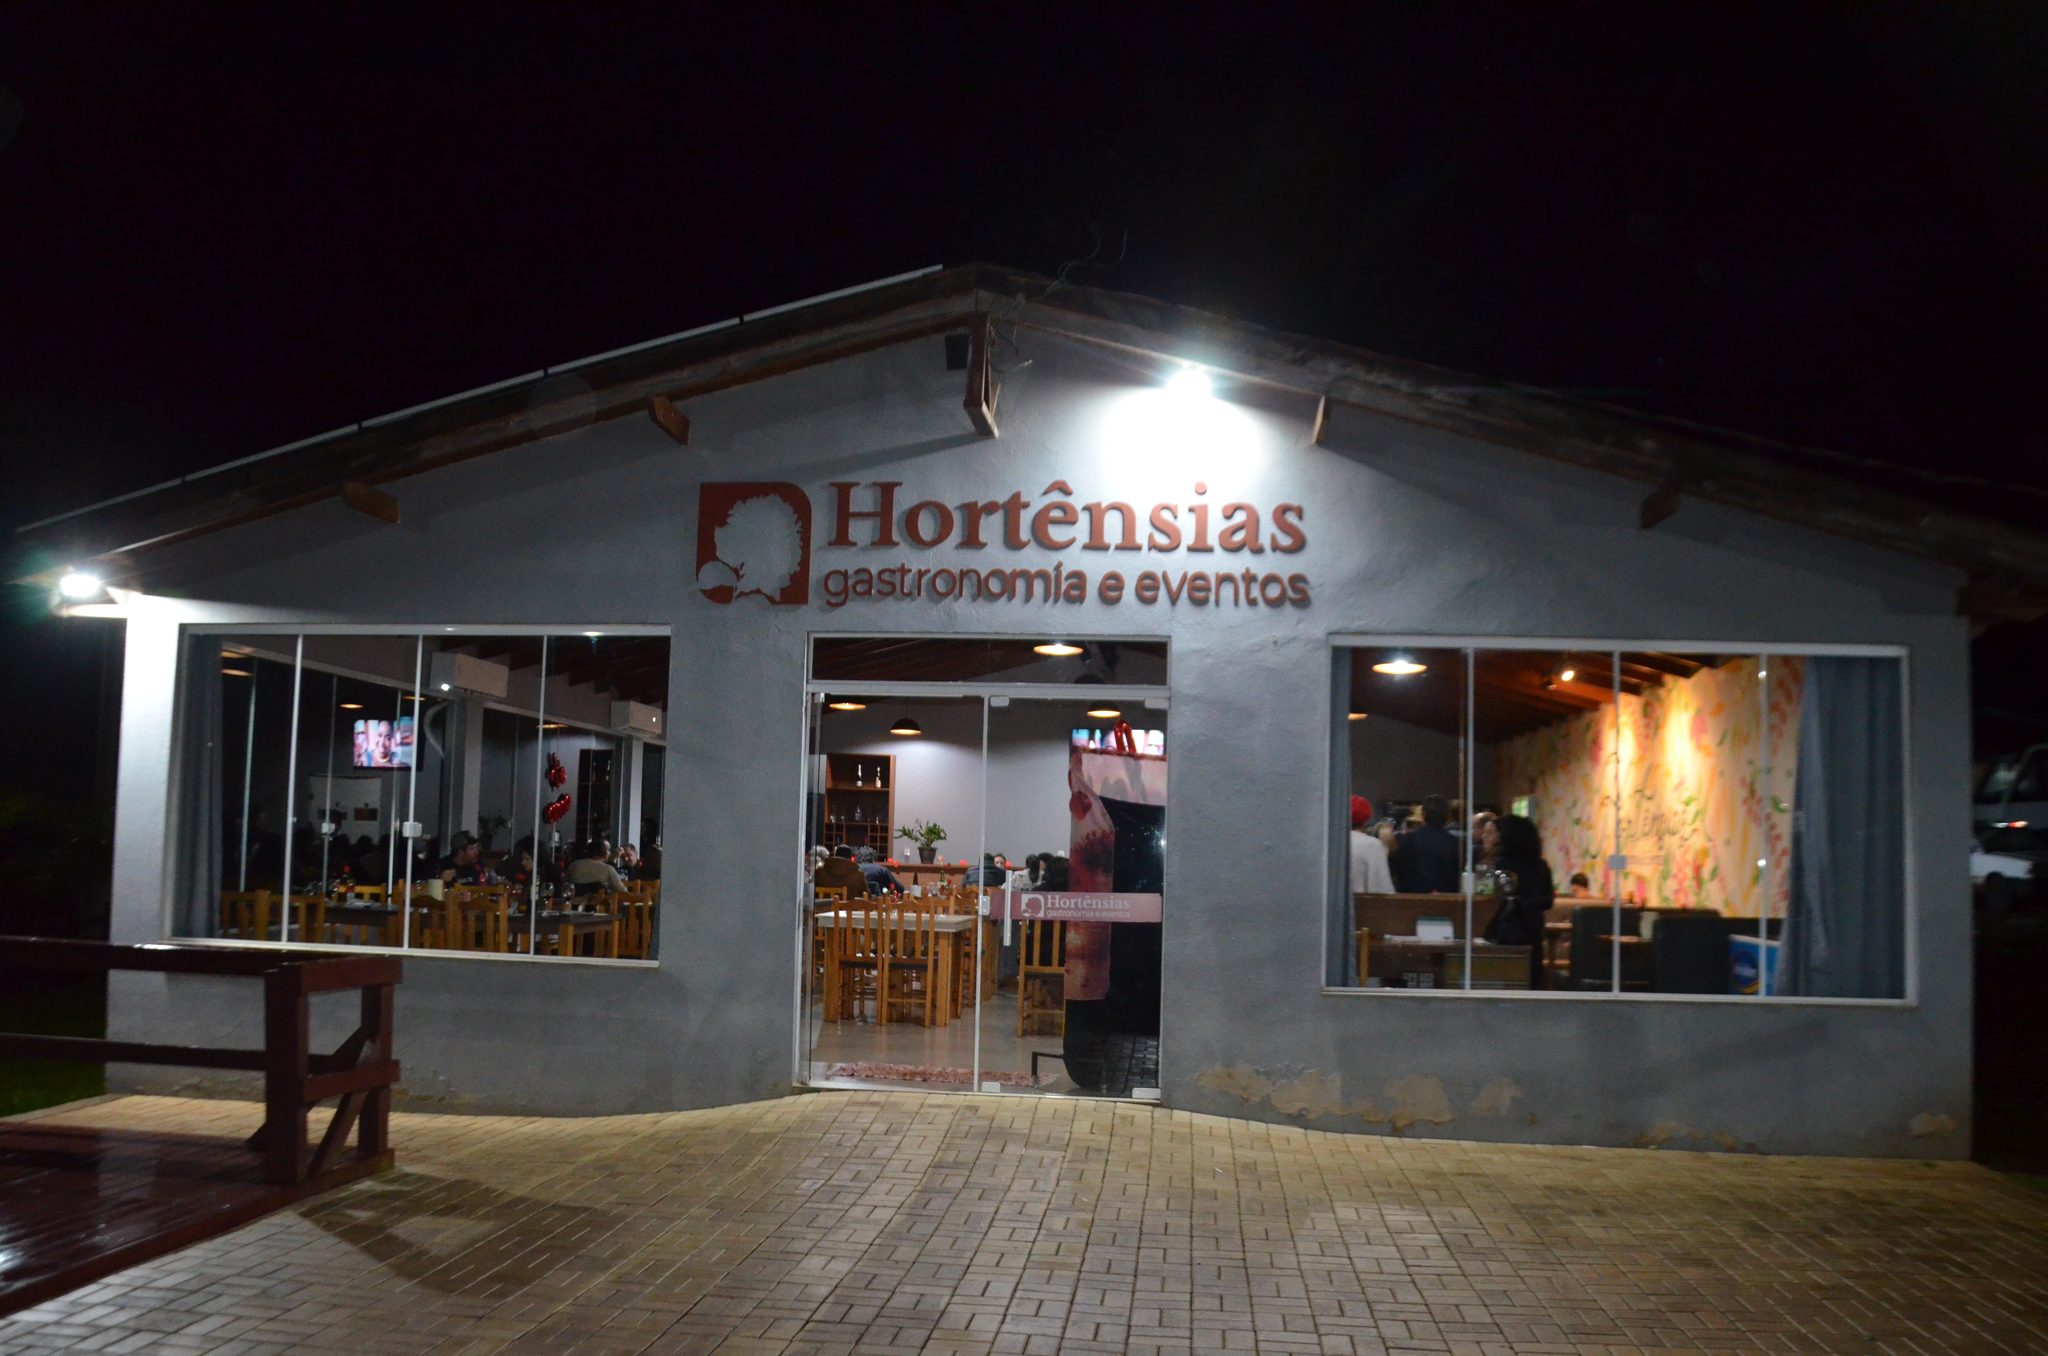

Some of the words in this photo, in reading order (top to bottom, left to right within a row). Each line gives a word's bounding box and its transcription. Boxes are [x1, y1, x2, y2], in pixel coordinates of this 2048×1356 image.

[827, 479, 1307, 553] Hortênsias
[1098, 570, 1126, 606] e
[1134, 566, 1311, 608] eventos
[1046, 894, 1131, 910] Hortênsias
